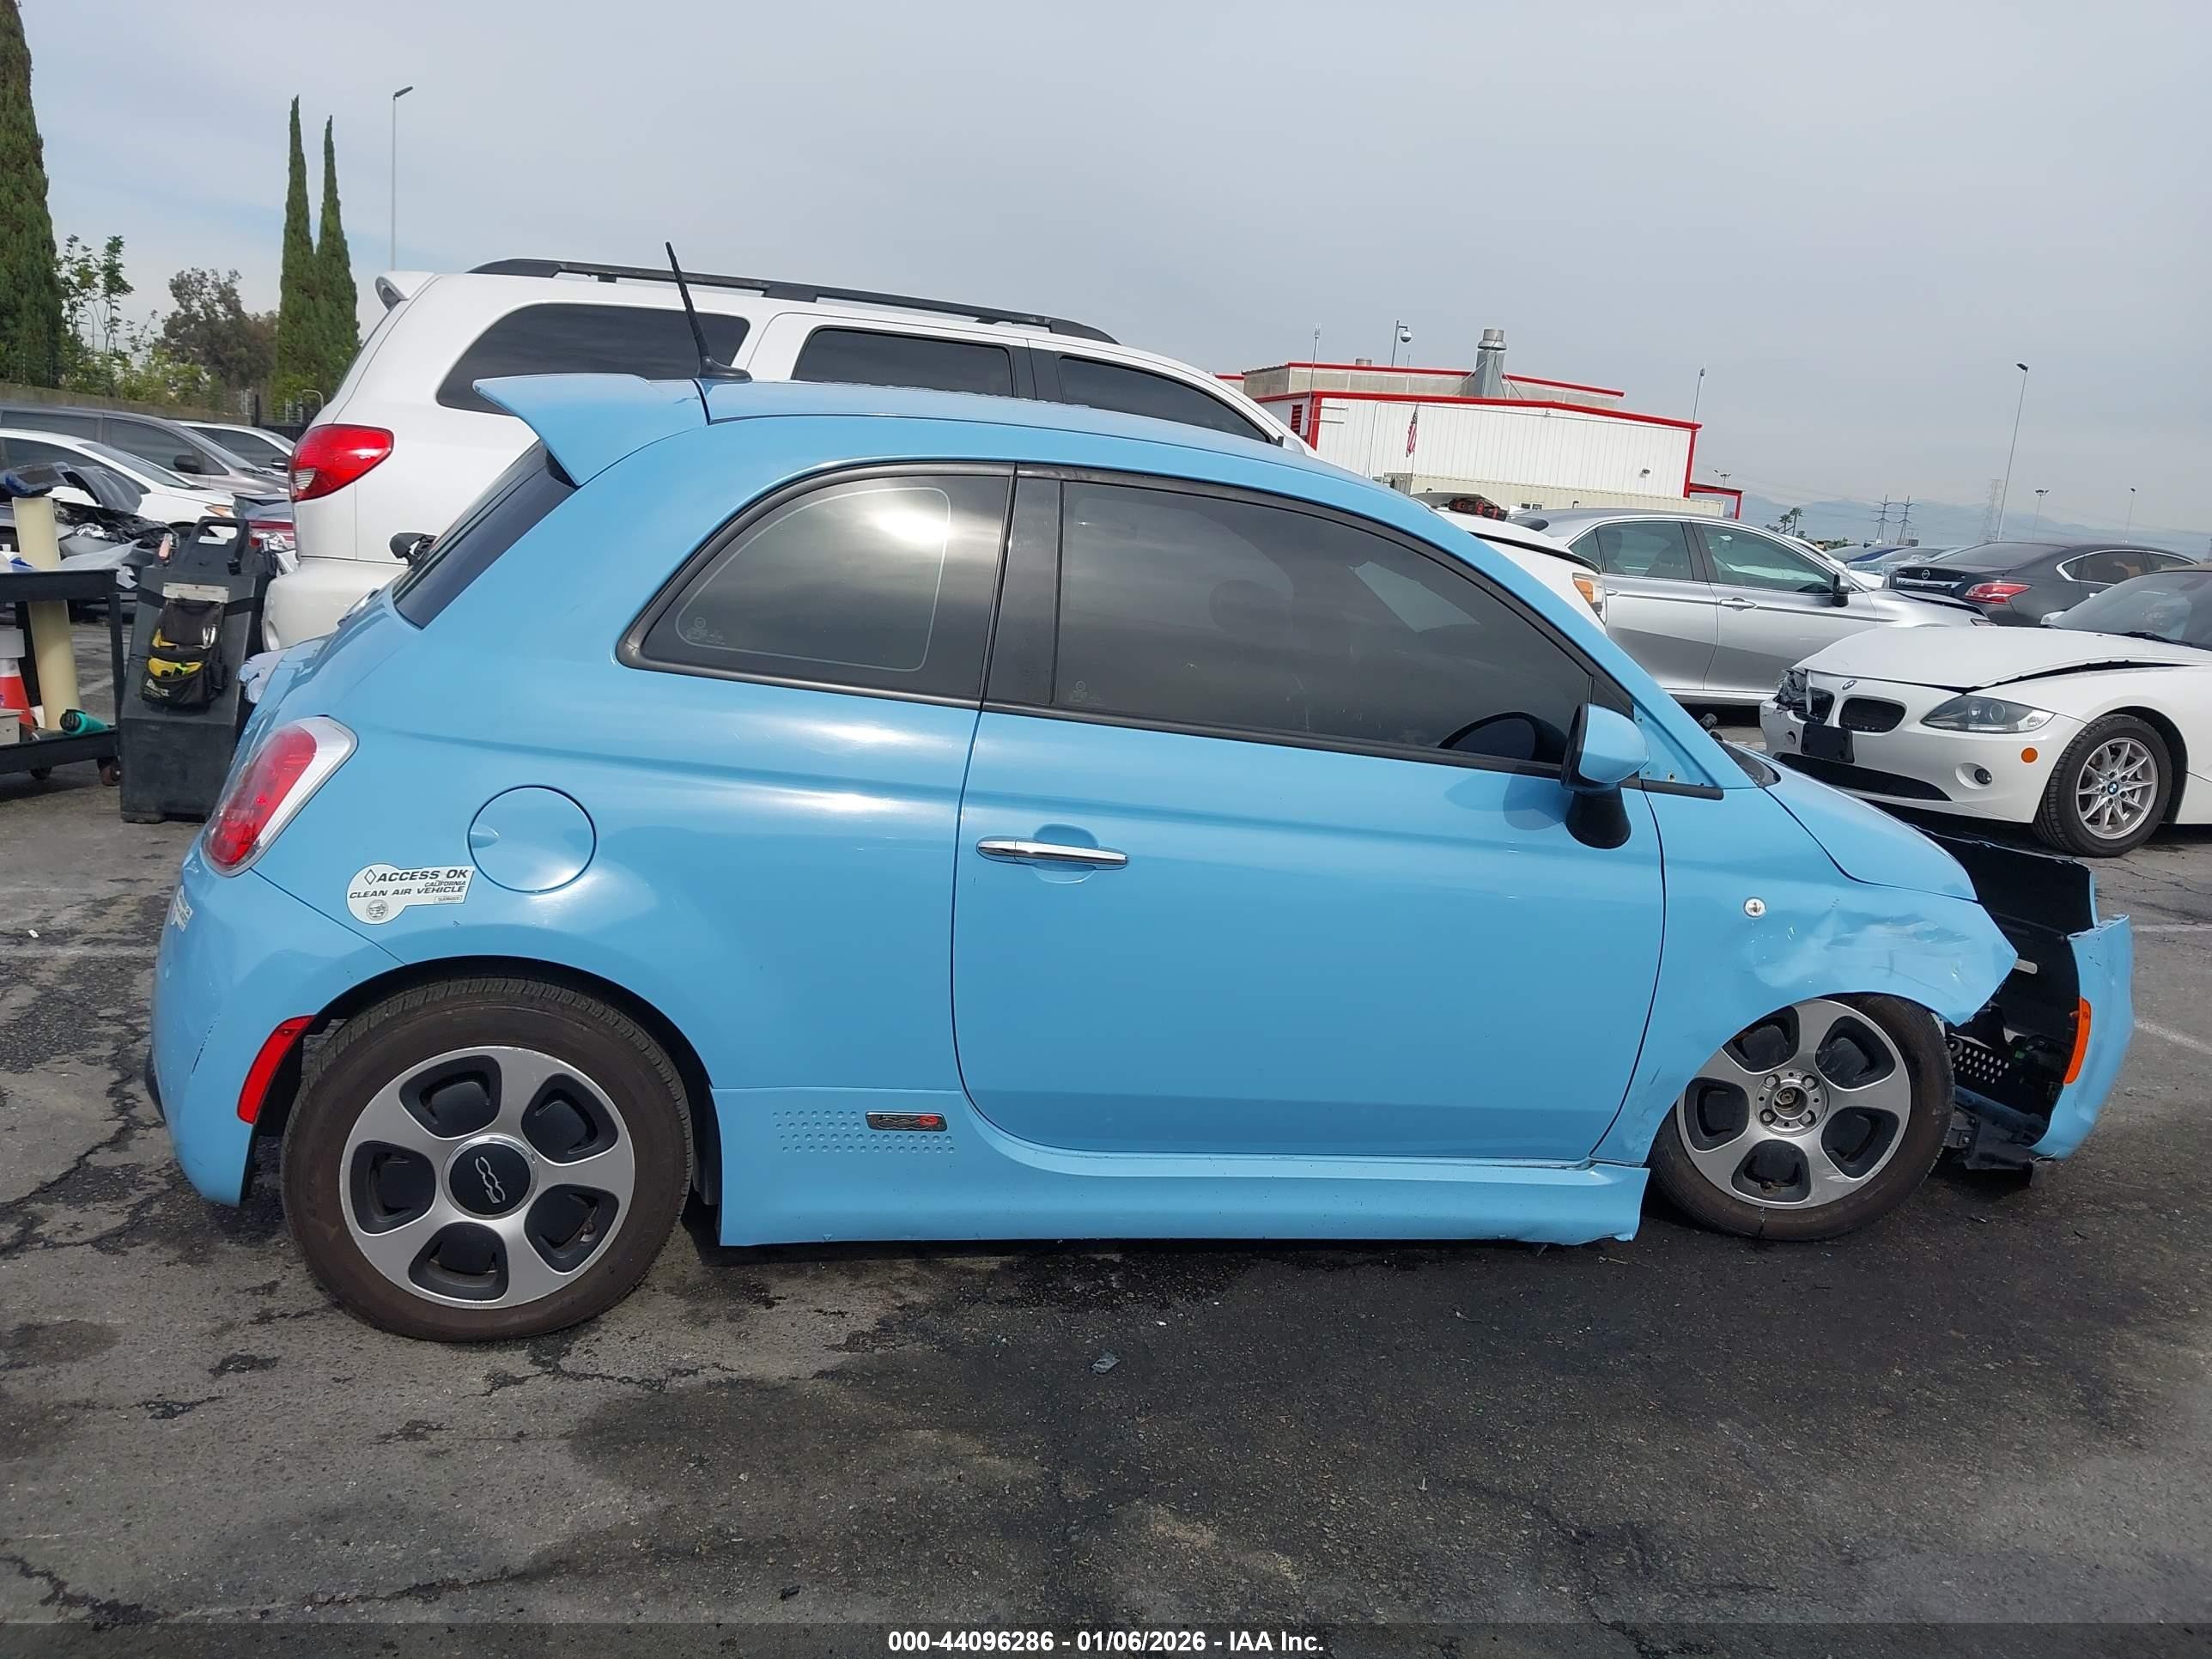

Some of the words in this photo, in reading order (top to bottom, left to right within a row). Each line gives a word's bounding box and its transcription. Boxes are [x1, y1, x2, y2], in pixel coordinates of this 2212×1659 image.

[375, 870, 441, 883] ACCESS
[446, 869, 469, 879] OK
[349, 890, 388, 899] CLEAN
[416, 885, 465, 895] VEHICLE
